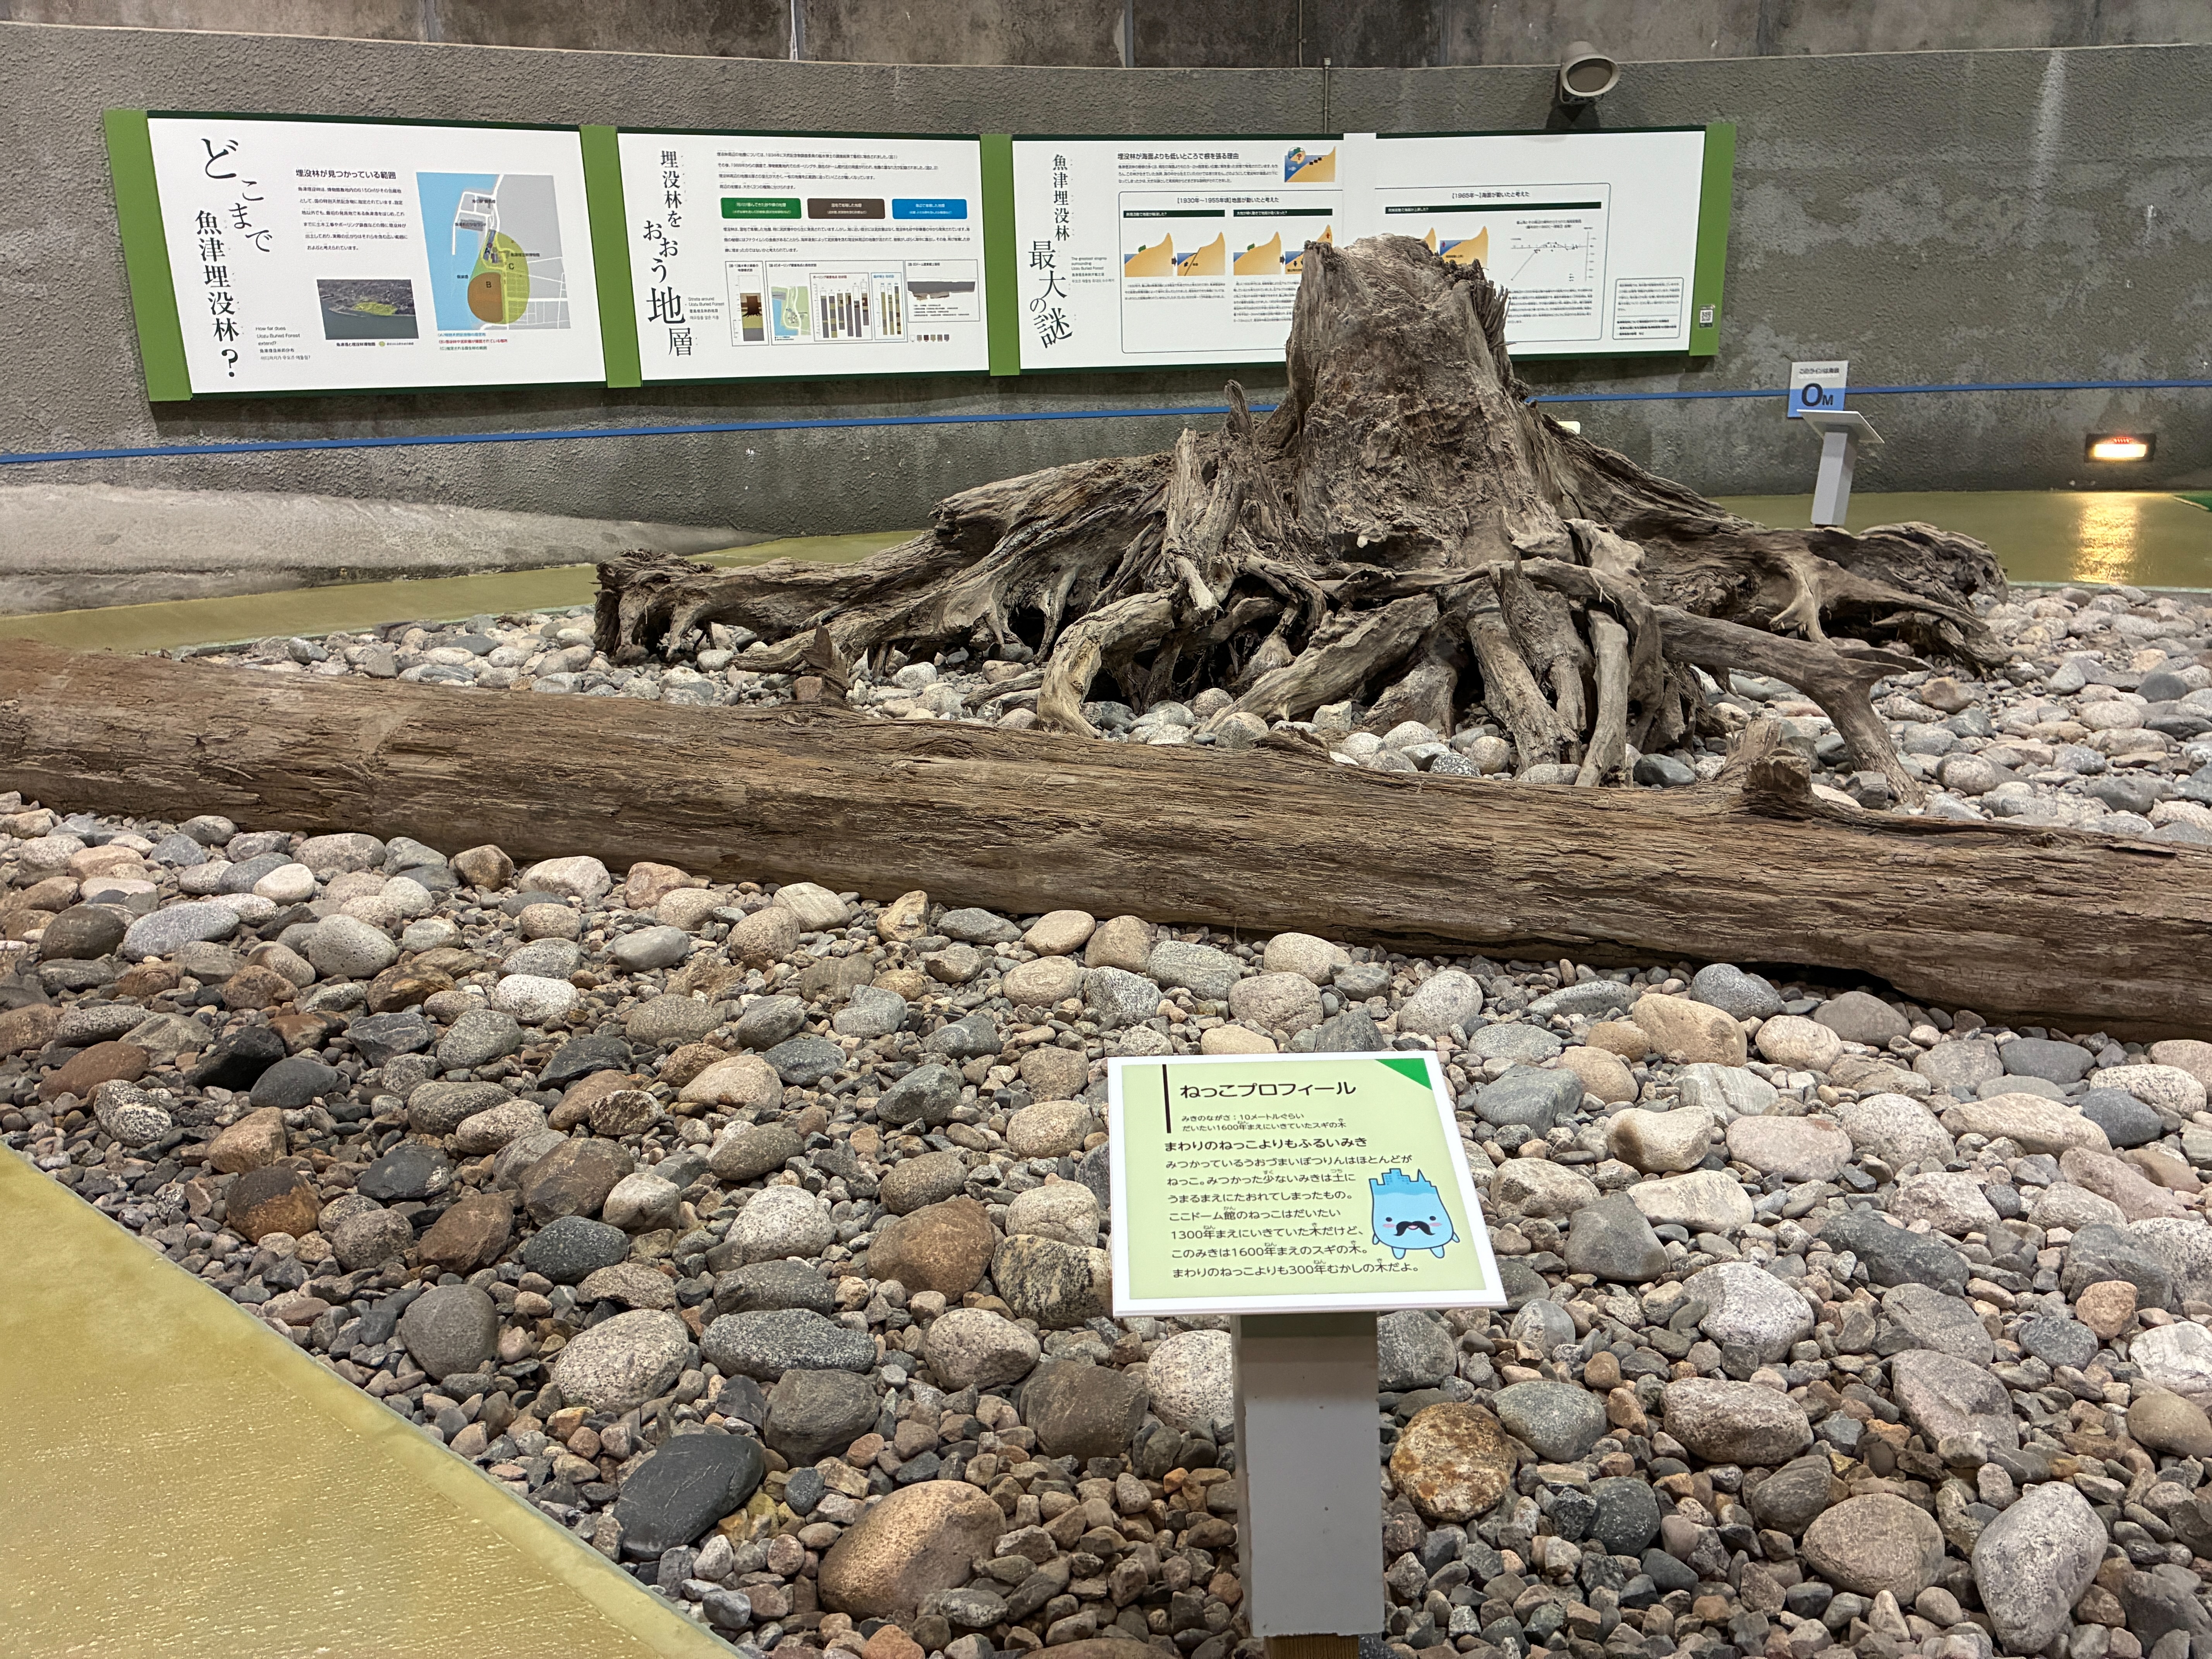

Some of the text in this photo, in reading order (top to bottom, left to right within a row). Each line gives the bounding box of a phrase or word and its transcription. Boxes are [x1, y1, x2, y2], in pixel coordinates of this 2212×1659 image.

[296, 169, 396, 179] 埋没林が見つかっている範囲
[201, 138, 272, 252] どこまで
[660, 150, 682, 228] 埋没林を
[1053, 155, 1070, 241] 魚津埋没林
[195, 210, 239, 377] 魚津埋没林？
[1029, 240, 1073, 348] 最大の謎
[1180, 1082, 1356, 1098] ねっこプロフィール
[1182, 1122, 1346, 1132] だいたい1600年まえにいきていたスギの木
[1164, 1137, 1367, 1152] まわりのねっこよりもふるいみき
[1166, 1154, 1413, 1169] みつかっているうおづまいぼつりんはほとんどが
[1167, 1173, 1356, 1186] ねっこ。みつかった少ないみきは土に
[1168, 1191, 1352, 1204] うまるまえにたおれてしまったもの。
[1170, 1209, 1341, 1221] ここドーム館のねっこはだいたい
[1171, 1226, 1363, 1239] 1300年まえにいきていた木だけど、
[1172, 1245, 1367, 1259] このみきは1600年まえのスギの木。
[1173, 1262, 1418, 1278] まわりのねっこよりも300年むかしの木だよ。
